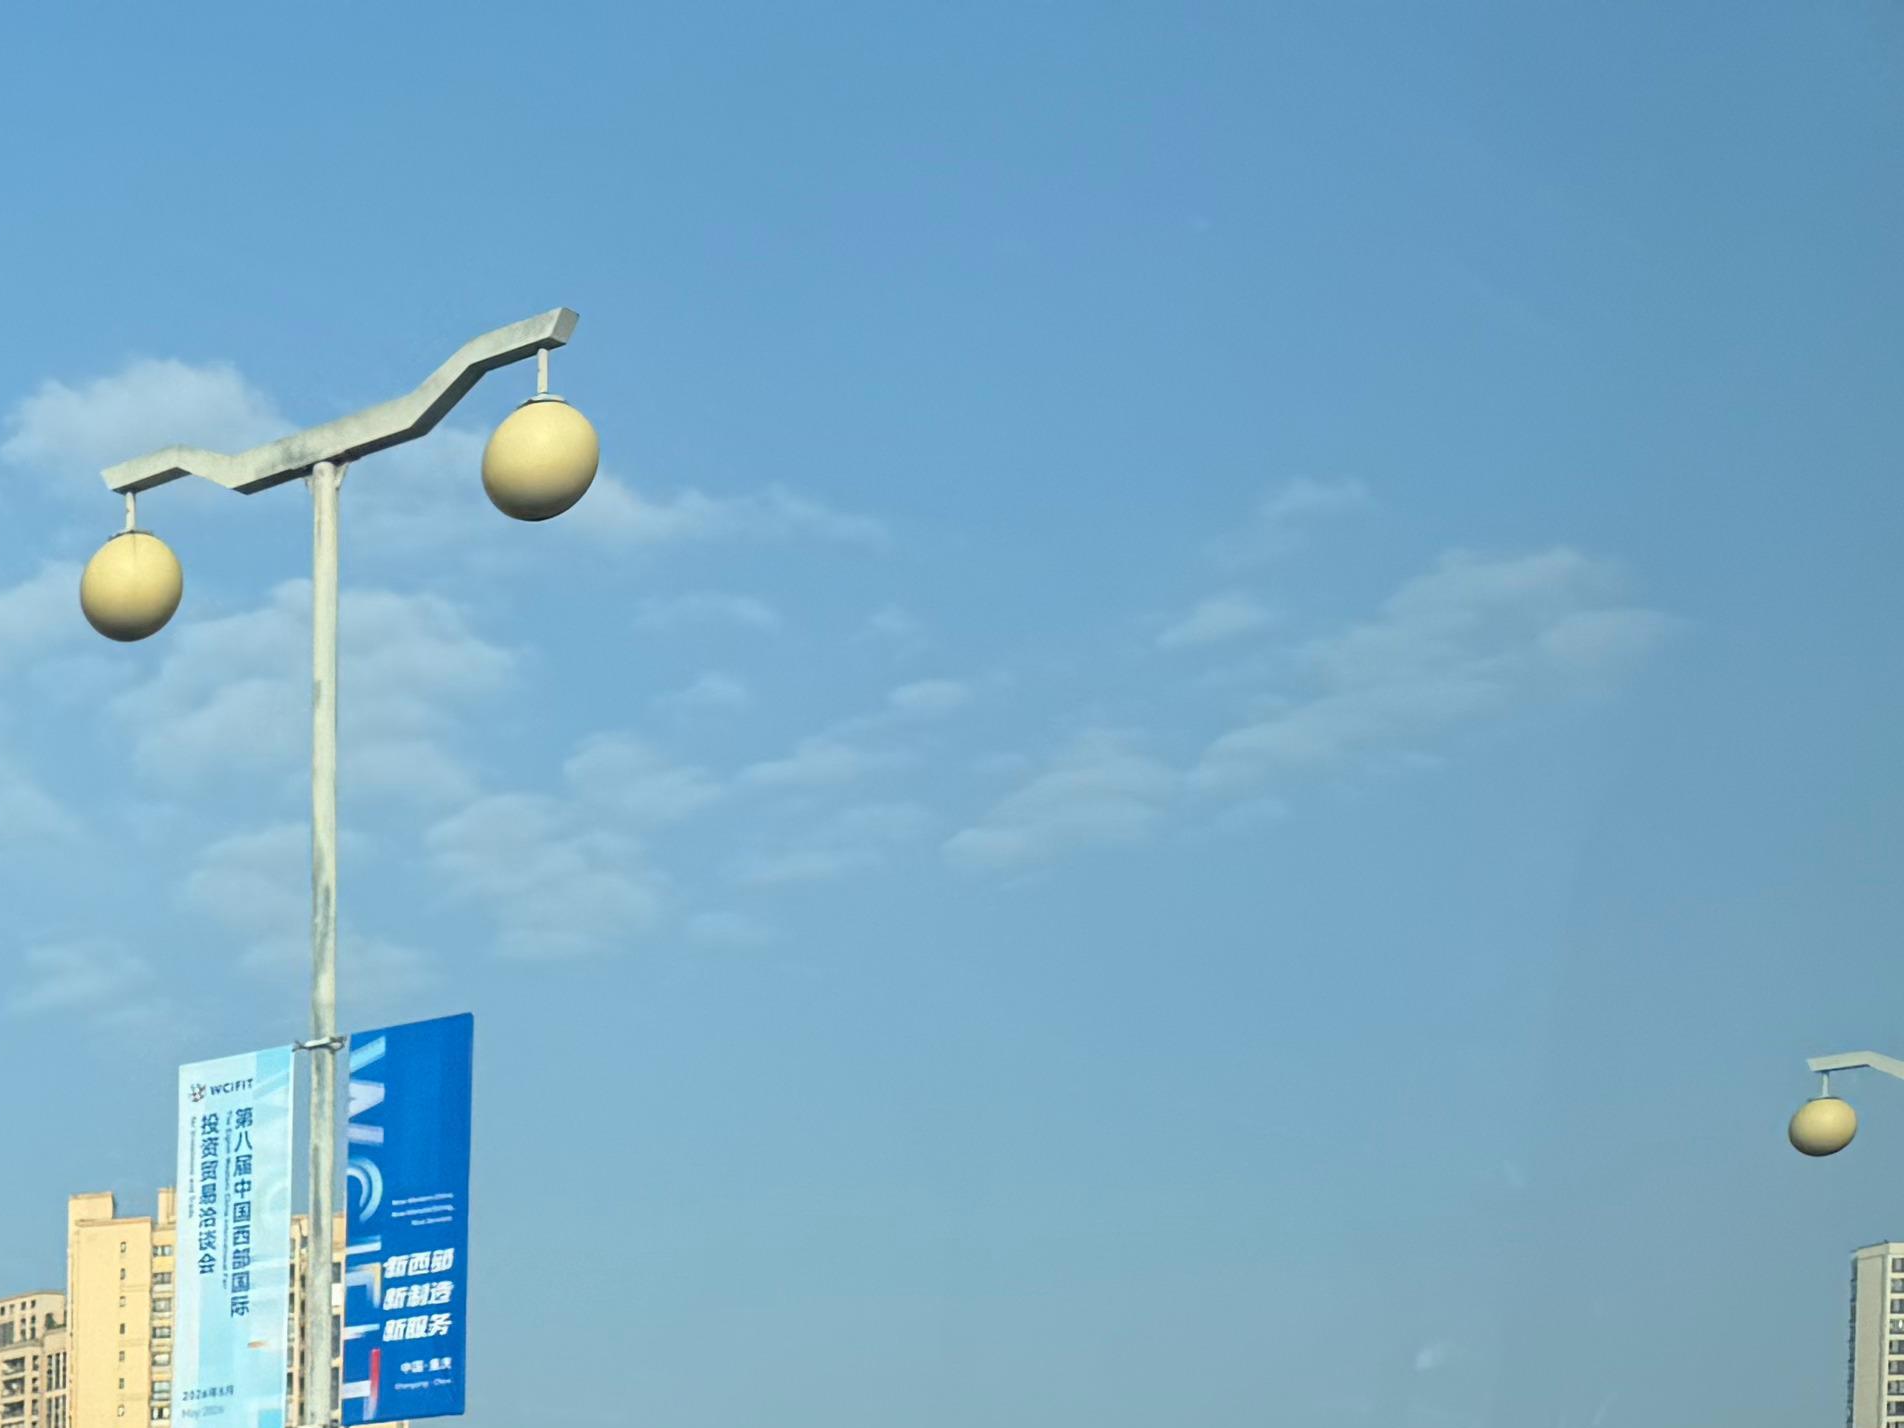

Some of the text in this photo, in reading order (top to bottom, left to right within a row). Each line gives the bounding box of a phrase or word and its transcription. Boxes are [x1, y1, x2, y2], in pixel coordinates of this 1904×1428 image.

[199, 1113, 219, 1274] 投资贸易洽谈会
[231, 1107, 253, 1318] 第八届中国西部国际
[383, 1247, 455, 1279] 新西部
[382, 1280, 454, 1311] 新制造
[382, 1312, 453, 1342] 新服务
